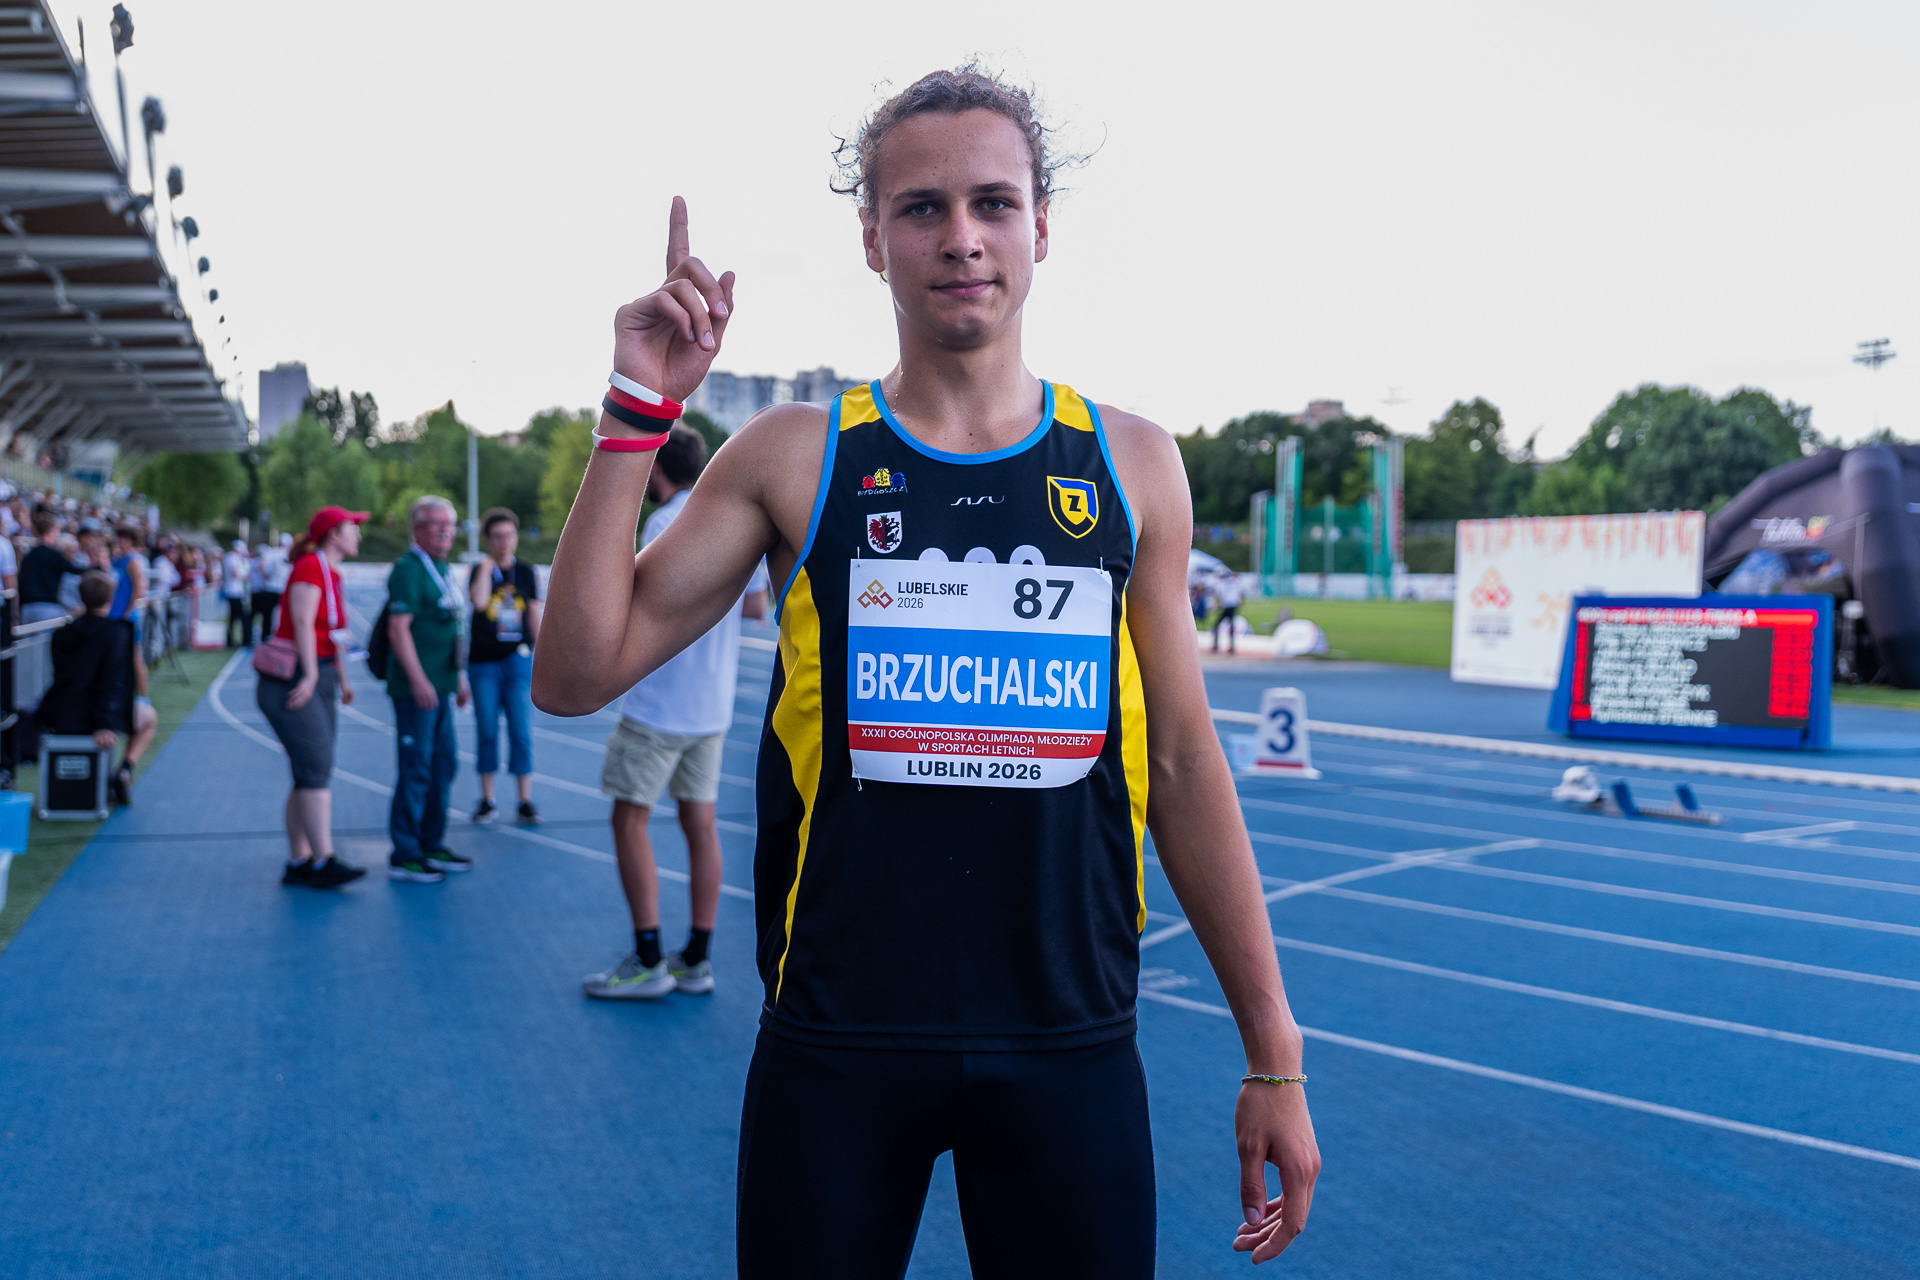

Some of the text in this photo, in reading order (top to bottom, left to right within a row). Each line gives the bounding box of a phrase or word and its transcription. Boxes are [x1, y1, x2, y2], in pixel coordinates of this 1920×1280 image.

[857, 486, 904, 496] BYDGOSZCZ
[1067, 494, 1082, 512] Z
[897, 581, 969, 596] LUBELSKIE
[897, 597, 924, 609] 2026
[1012, 577, 1075, 620] 87
[856, 652, 1098, 709] BRZUCHALSKI
[861, 727, 1093, 746] XXXII OGÓLNOPOLSKA OLIMPIADA MŁODZIEŻY
[1268, 707, 1296, 754] 3
[918, 742, 1035, 756] W SPORTACH LETNICH
[907, 760, 1042, 780] LUBLIN 2026
